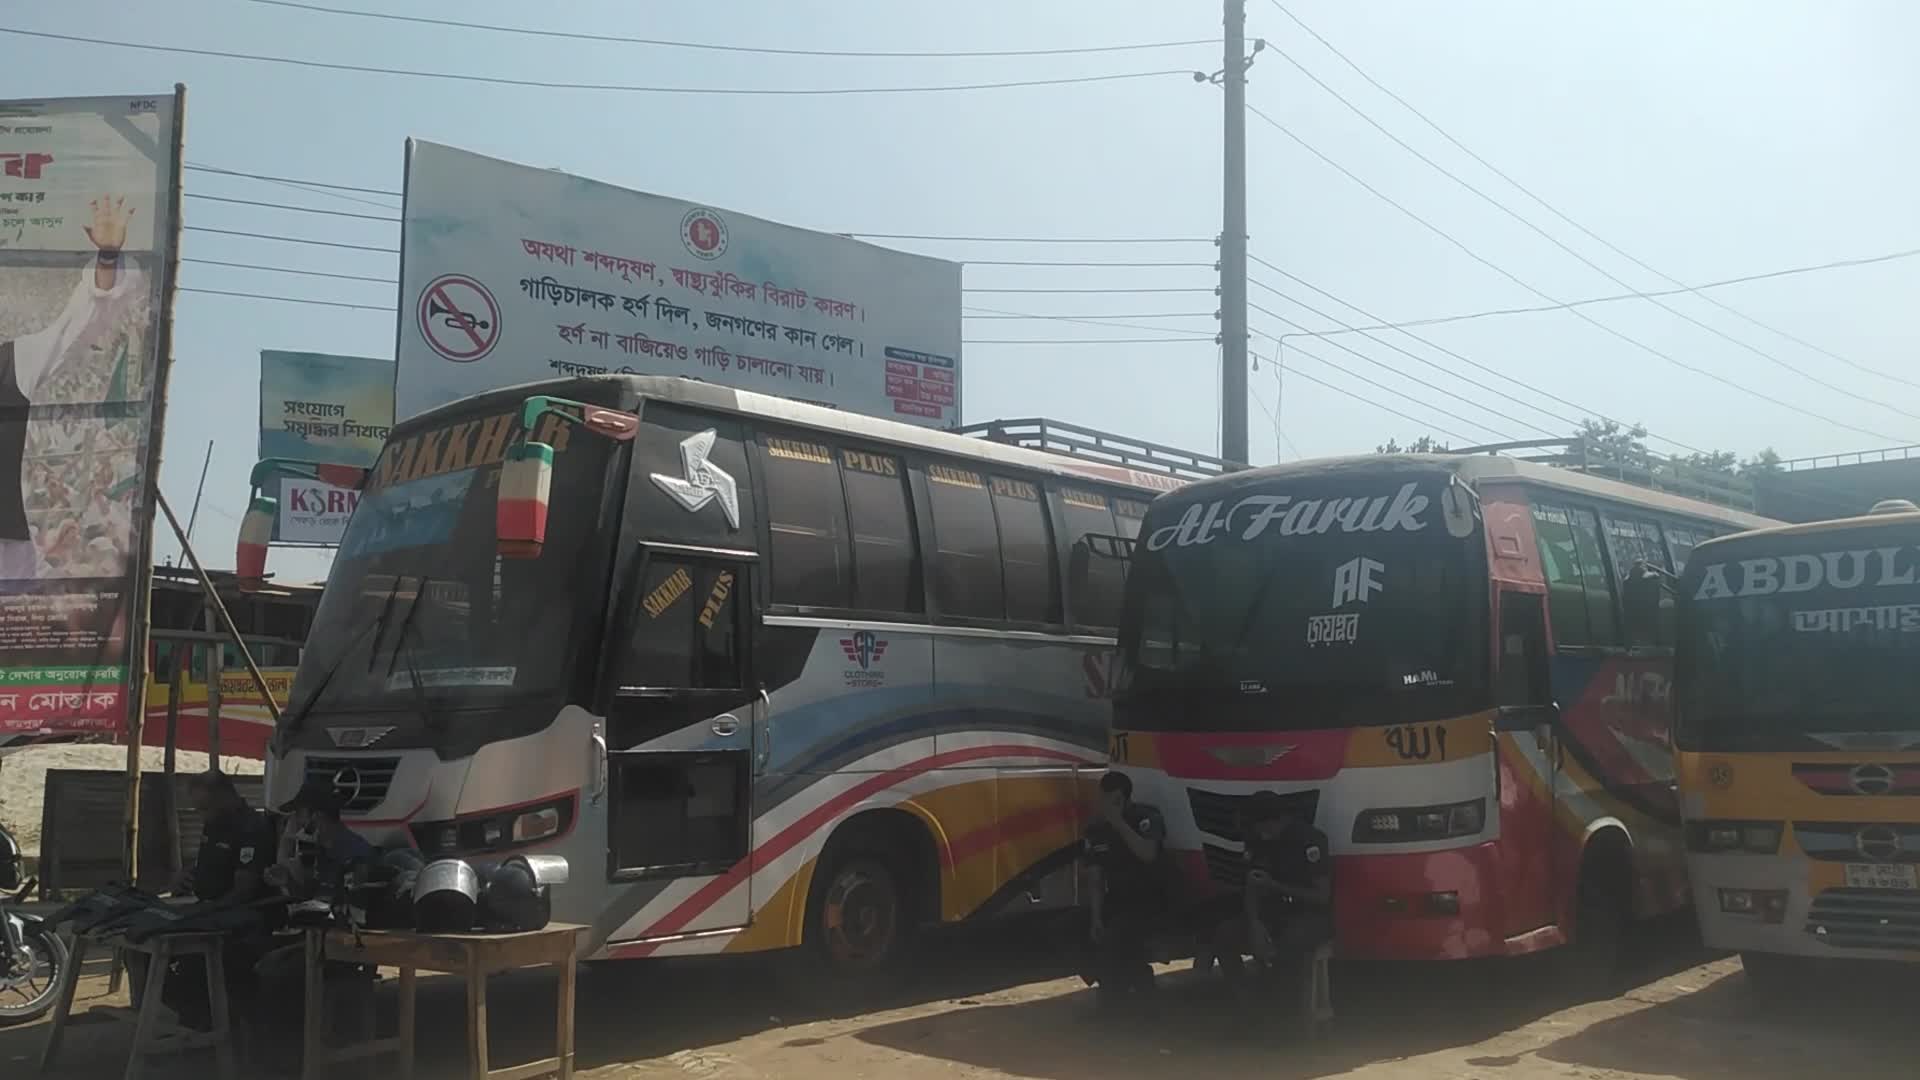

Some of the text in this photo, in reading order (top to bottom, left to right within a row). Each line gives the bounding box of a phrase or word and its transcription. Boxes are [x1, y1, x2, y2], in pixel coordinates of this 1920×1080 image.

[520, 239, 576, 267] অযথা
[763, 281, 808, 309] বিরাট
[520, 276, 616, 312] গাড়িচালক
[621, 294, 650, 318] হর্ণ
[704, 310, 778, 341] জনগণের
[783, 326, 817, 348] কান
[557, 323, 586, 345] হর্ণ
[590, 330, 610, 350] না
[616, 332, 688, 361] বাজিয়েও
[694, 346, 731, 372] গাড়ি
[736, 353, 793, 380] চালানো
[283, 417, 390, 441] সমৃদ্ধির শিখরে
[284, 400, 345, 418] সংযোগে
[843, 449, 896, 476] PLUS
[993, 478, 1037, 500] PLUS
[1693, 546, 1920, 601] ABDUL
